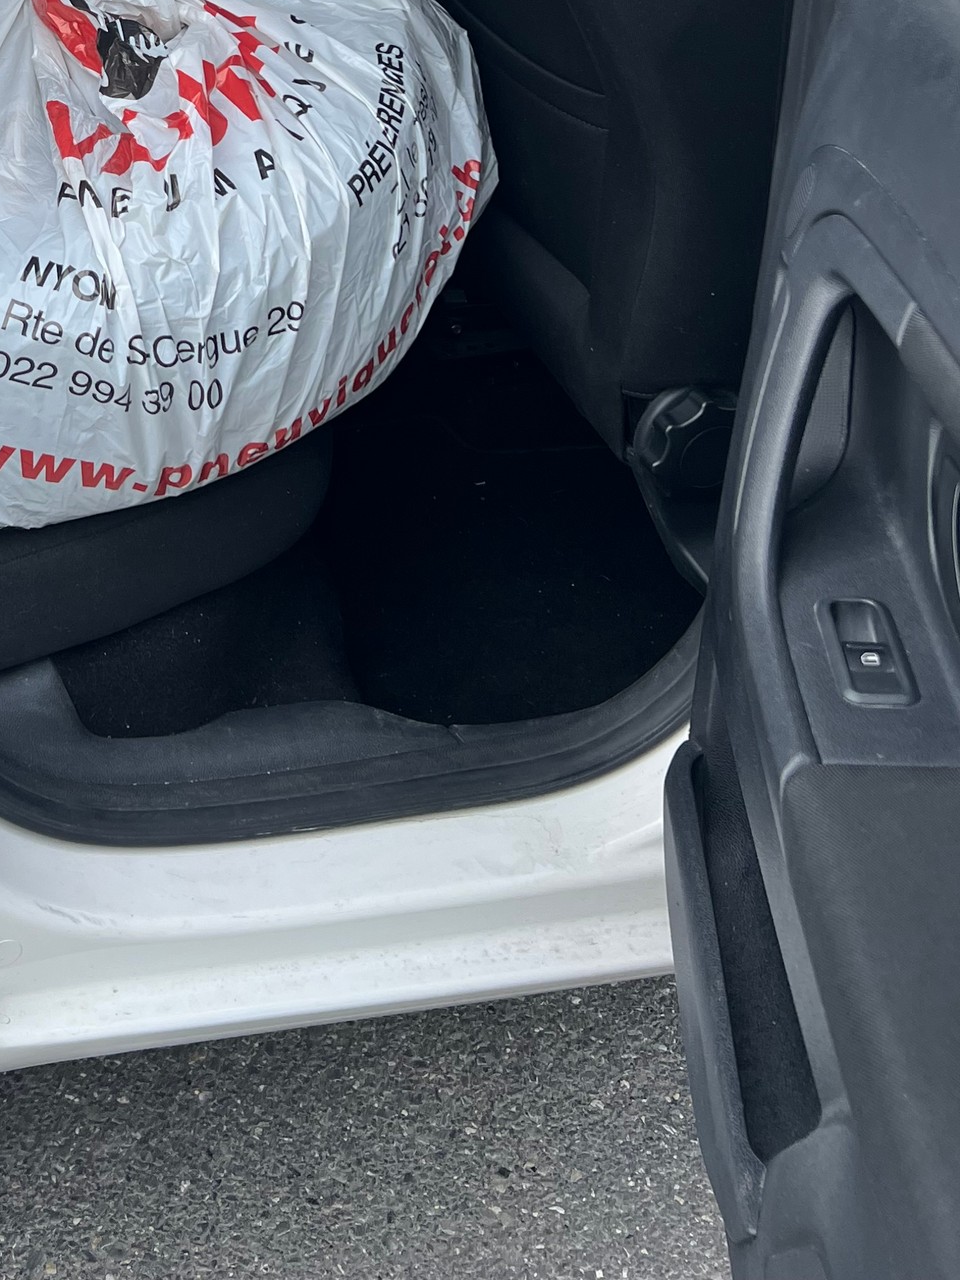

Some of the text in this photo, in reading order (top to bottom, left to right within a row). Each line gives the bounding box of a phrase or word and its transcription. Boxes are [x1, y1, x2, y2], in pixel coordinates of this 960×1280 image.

[20, 256, 117, 310] NYON
[0, 298, 63, 345] Rte
[75, 327, 115, 364] de
[267, 300, 307, 337] 29
[68, 370, 133, 412] 994
[142, 381, 174, 415] 39
[188, 378, 223, 410] 00
